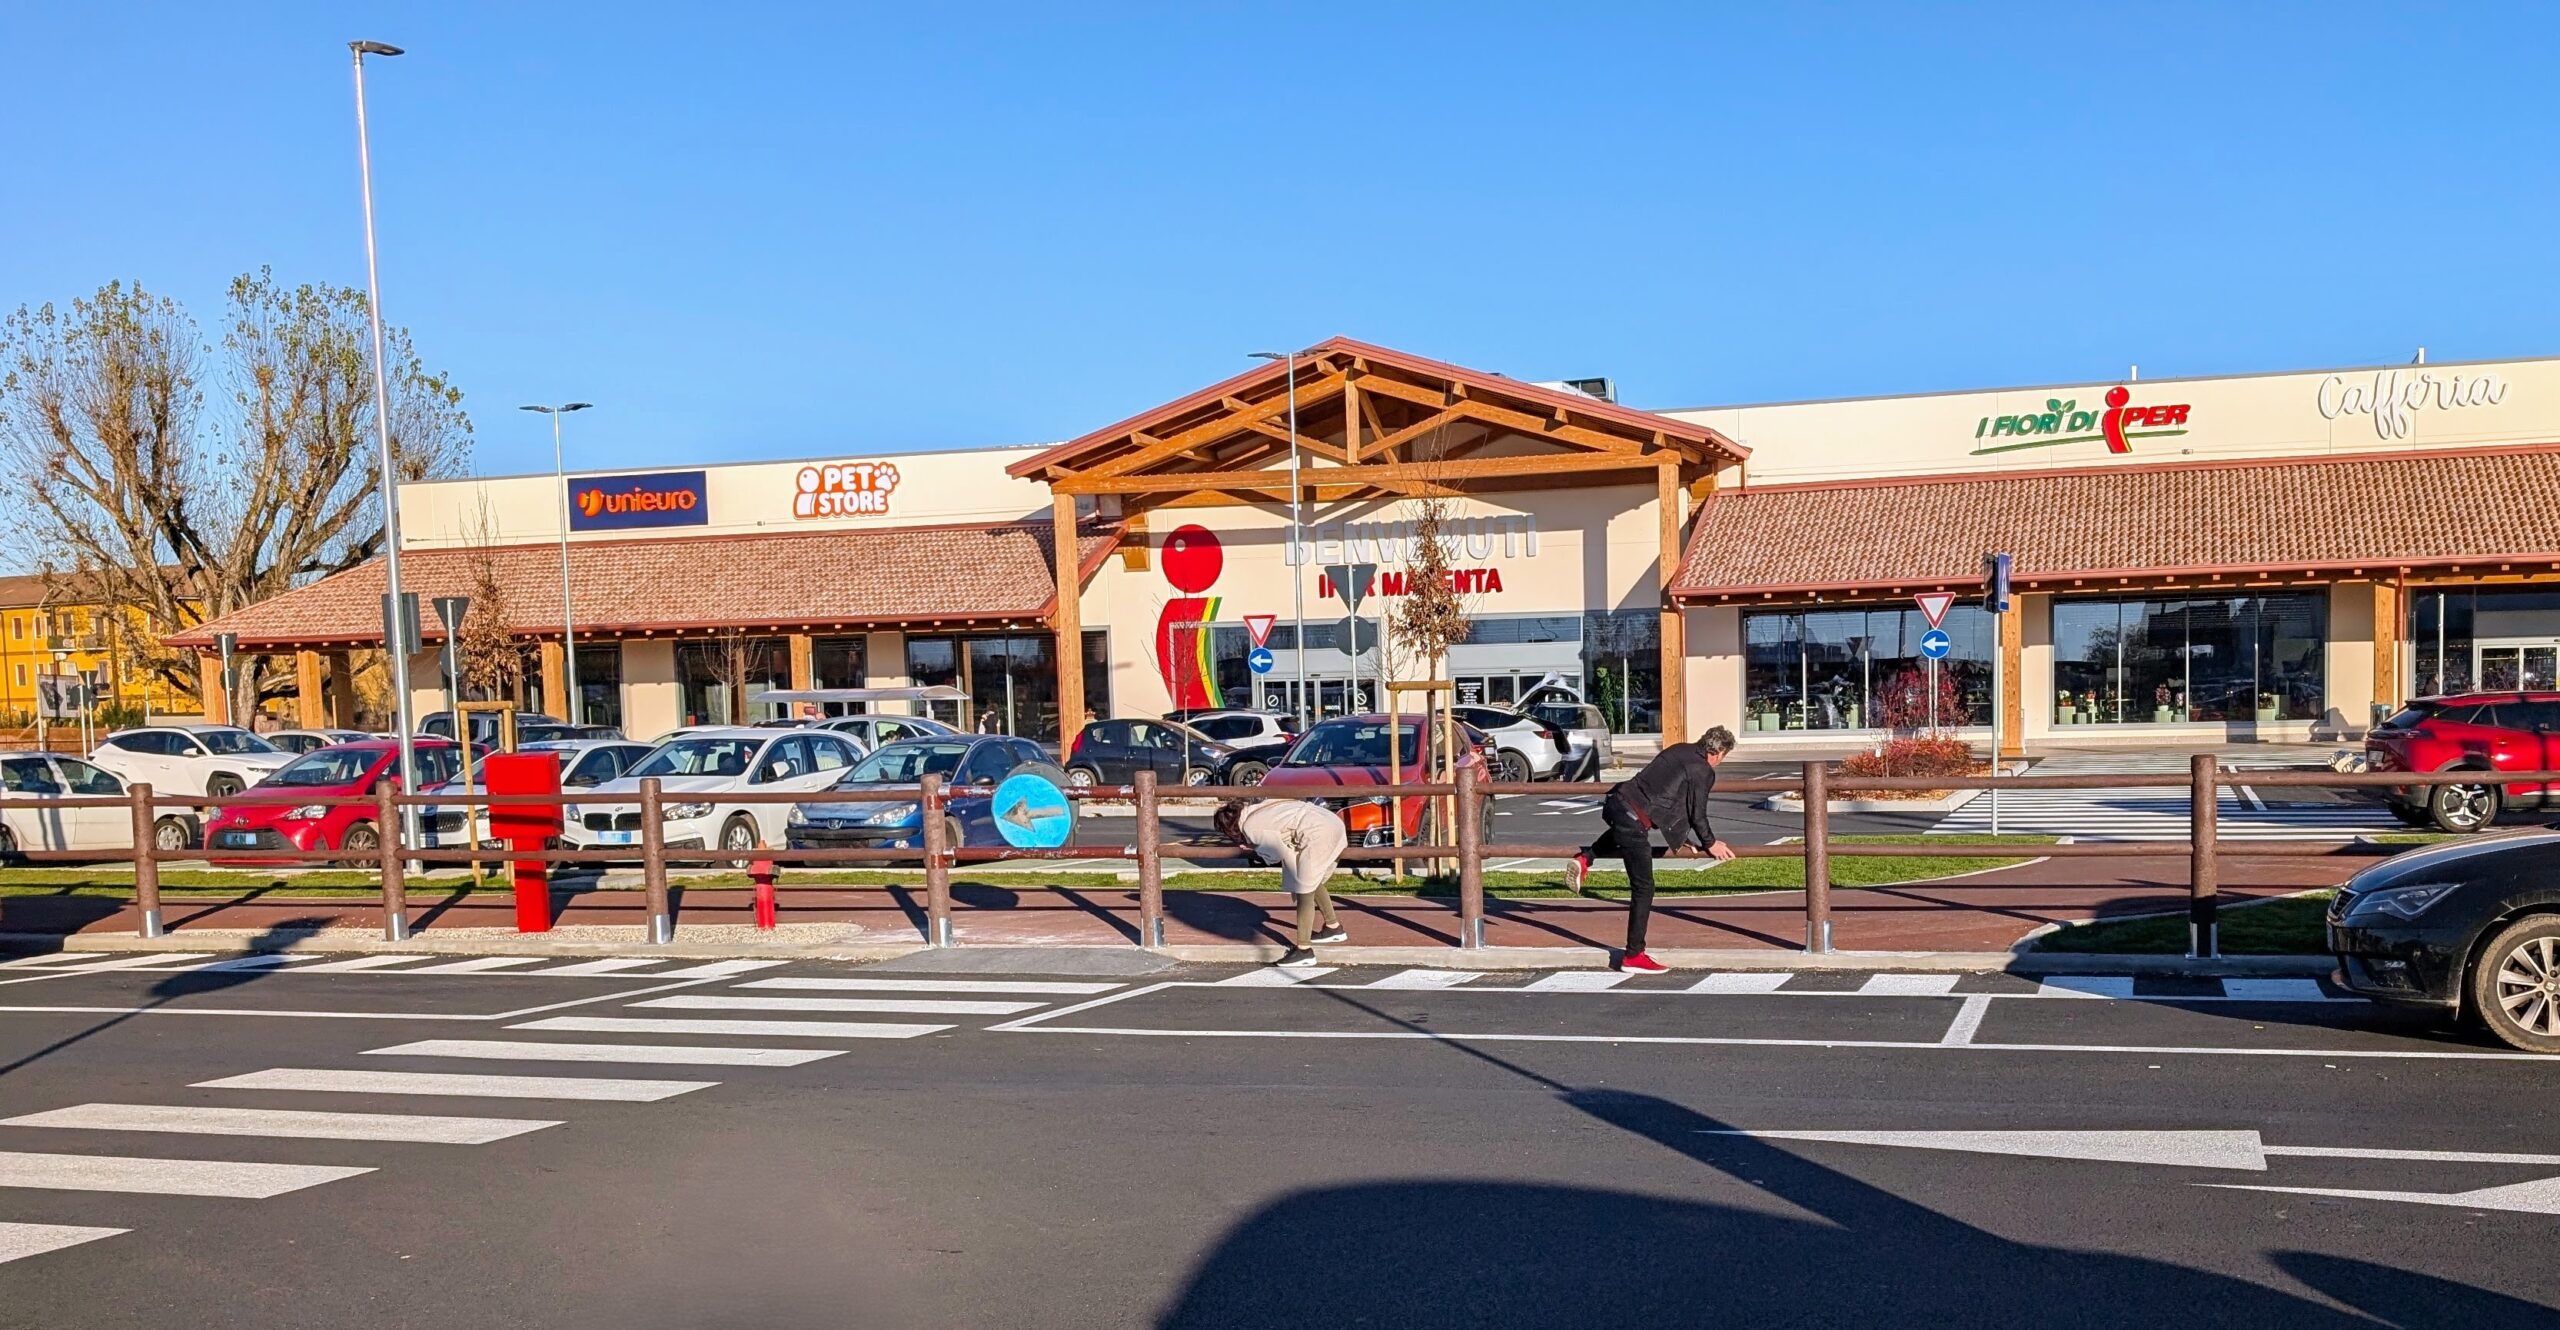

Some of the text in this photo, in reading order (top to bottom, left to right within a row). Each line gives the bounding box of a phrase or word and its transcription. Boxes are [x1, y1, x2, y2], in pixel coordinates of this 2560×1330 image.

[2318, 371, 2509, 440] Cafferia
[1990, 409, 2064, 437] FIORI
[2065, 409, 2100, 432] DI
[824, 465, 874, 491] PET
[605, 487, 697, 513] unieuro
[818, 489, 886, 514] STORE
[1319, 568, 1503, 598] IR MAENTA
